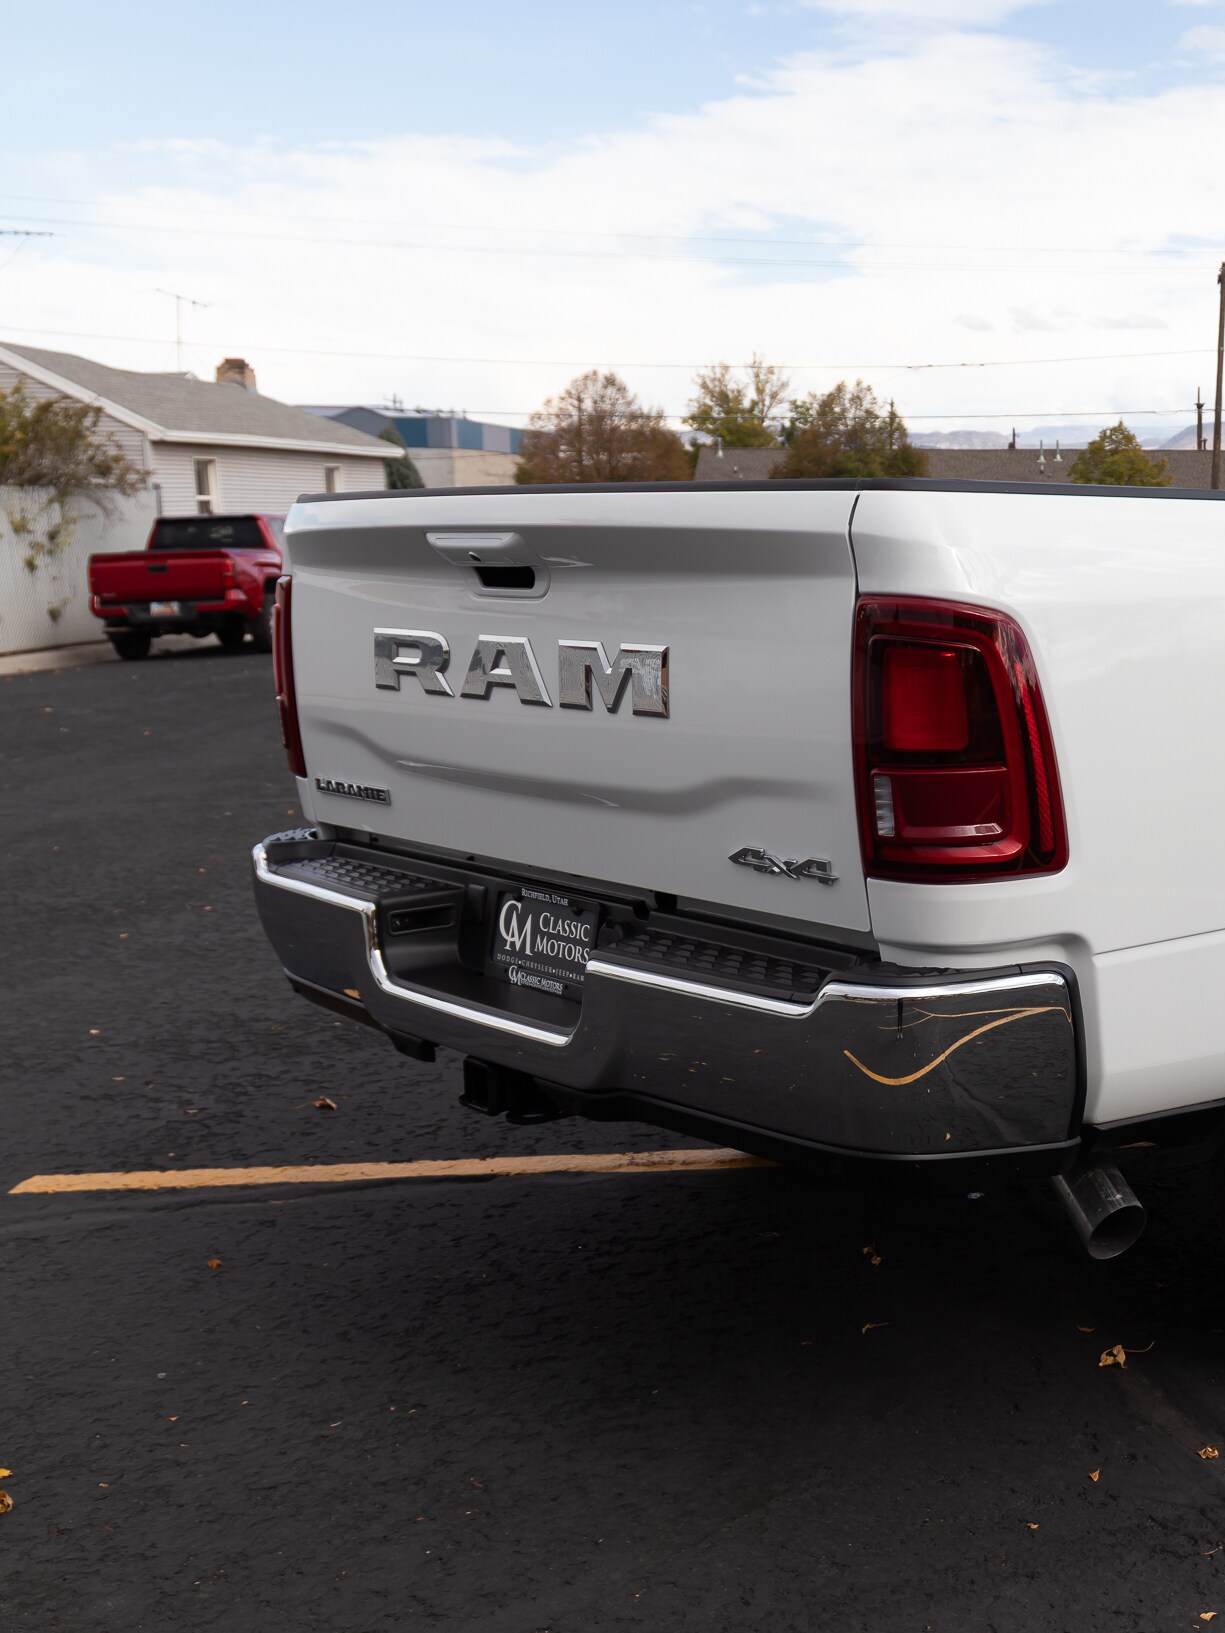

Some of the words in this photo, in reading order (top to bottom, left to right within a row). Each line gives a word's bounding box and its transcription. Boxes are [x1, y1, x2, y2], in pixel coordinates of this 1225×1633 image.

[373, 627, 669, 719] RAM
[315, 777, 391, 806] LARAMIE
[551, 894, 568, 906] UTAH
[539, 912, 590, 942] CLASSIC
[534, 933, 590, 965] MOTORS
